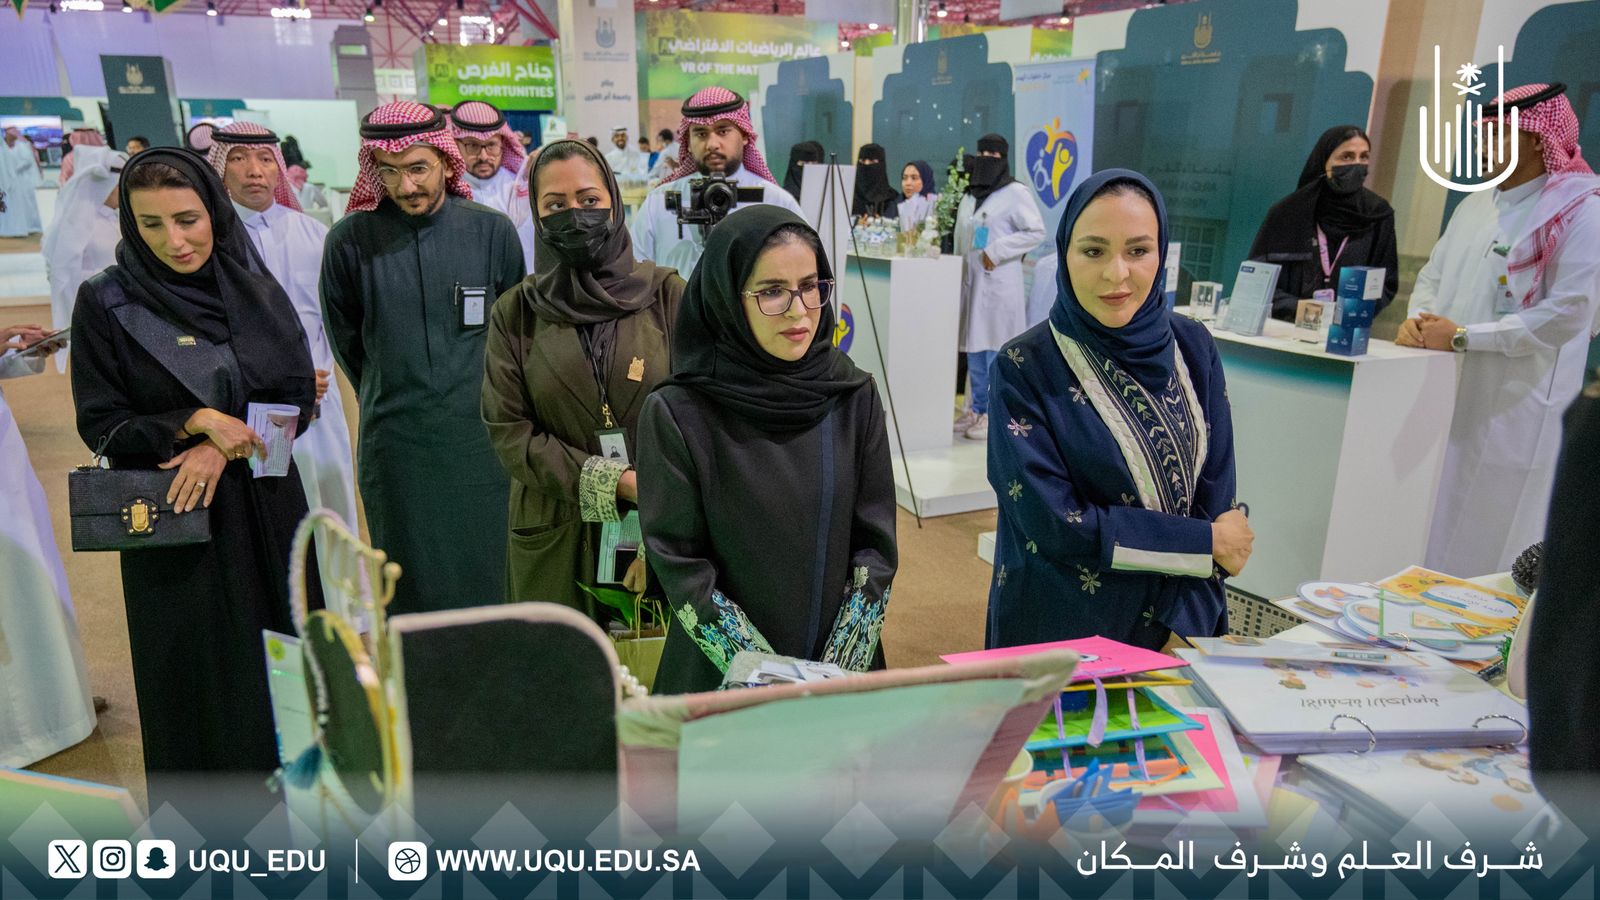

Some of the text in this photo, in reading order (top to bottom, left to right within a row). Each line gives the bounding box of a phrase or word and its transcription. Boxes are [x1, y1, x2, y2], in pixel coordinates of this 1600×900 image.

[736, 41, 793, 57] الرياضيات
[794, 42, 821, 58] عالم
[457, 62, 553, 82] جناح الفرص
[681, 62, 758, 75] VR OF THE MAT
[459, 84, 554, 98] OPPORTUNITIES
